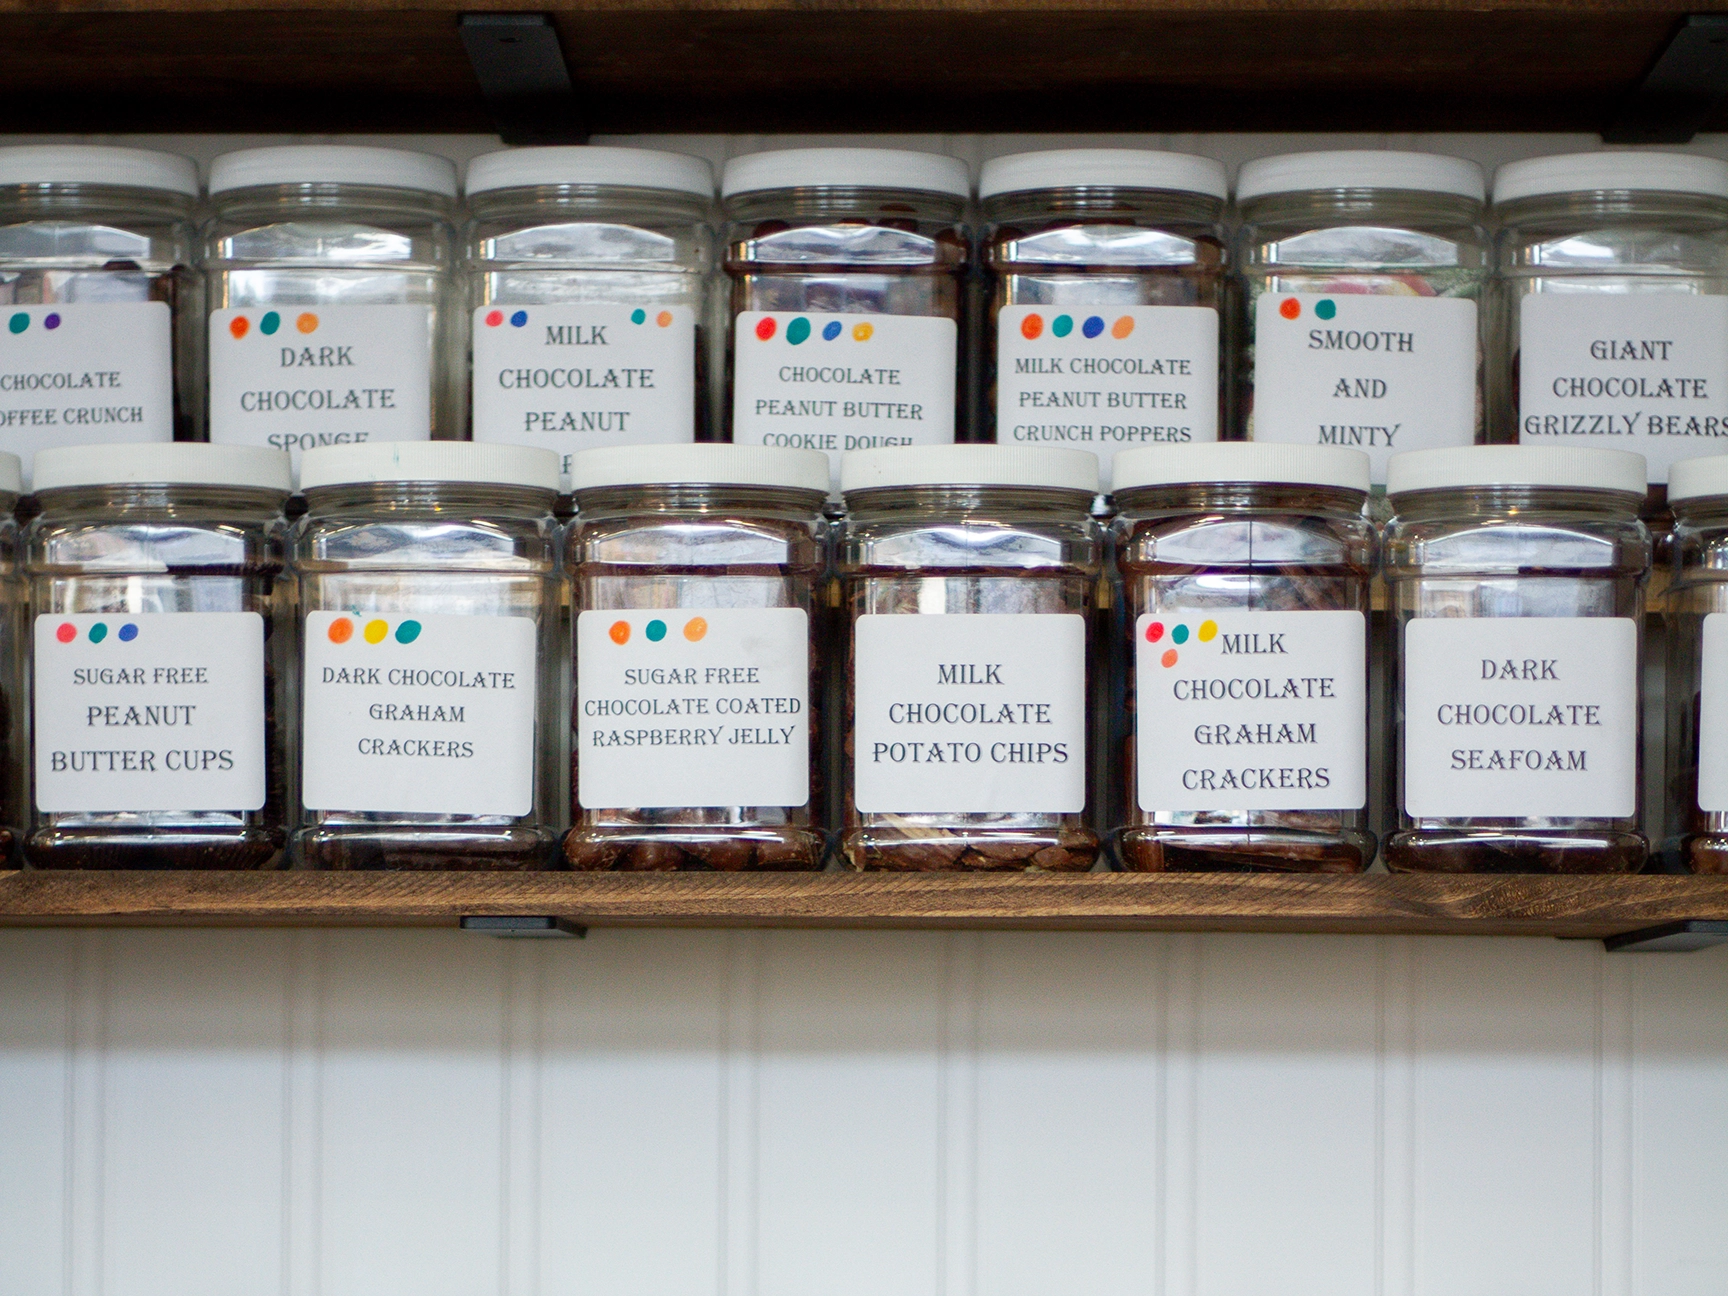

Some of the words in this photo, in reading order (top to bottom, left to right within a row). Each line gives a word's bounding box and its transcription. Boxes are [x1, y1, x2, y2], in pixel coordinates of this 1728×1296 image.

[545, 326, 608, 345] MILK
[1308, 329, 1414, 353] SMOOTH
[281, 346, 354, 367] DARK
[1590, 340, 1673, 361] GIANT
[779, 366, 901, 385] CHOCOLATE
[1015, 358, 1064, 374] MILK
[1070, 358, 1191, 375] CHOCOLATE
[0, 372, 121, 391] CHOCOLATE
[499, 368, 655, 389] CHOCOLATE
[1333, 378, 1387, 399] AND
[1552, 377, 1709, 399] CHOCOLATE
[240, 389, 396, 412] CHOCOLATE
[755, 399, 837, 416] PEANUT
[843, 401, 923, 421] BUTTER
[1019, 391, 1101, 407] PEANUT
[1107, 392, 1187, 410] BUTTER
[63, 407, 143, 425] CRUNCH
[525, 412, 630, 432] PEANUT
[1524, 411, 1642, 436] GRIZZLY
[763, 433, 837, 450] COOKIE
[844, 435, 912, 451] DOUGH
[1013, 425, 1093, 441] CRUNCH
[1100, 425, 1192, 443] POPPERS
[1318, 423, 1401, 447] MINTY
[1221, 633, 1288, 655] MILK
[73, 668, 146, 685] SUGAR
[153, 667, 208, 685] FREE
[322, 667, 381, 685] DARK
[388, 669, 515, 689] CHOCOLATE
[624, 668, 697, 685] SUGAR
[705, 667, 760, 685] FREE
[937, 664, 1004, 685] MILK
[1481, 659, 1559, 681] DARK
[1173, 678, 1336, 701] CHOCOLATE
[87, 705, 196, 727] PEANUT
[369, 703, 465, 723] GRAHAM
[585, 698, 709, 717] CHOCOLATE
[716, 698, 801, 714] COATED
[889, 703, 1052, 724] CHOCOLATE
[1437, 704, 1602, 726] CHOCOLATE
[593, 725, 724, 747] RASPBERRY
[728, 725, 795, 745] JELLY
[1194, 723, 1317, 746] GRAHAM
[358, 738, 474, 758] CRACKERS
[873, 742, 982, 763] POTATO
[990, 742, 1069, 764] CHIPS
[51, 750, 157, 772] BUTTER
[165, 749, 234, 771] CUPS
[1451, 749, 1587, 771] SEAFOAM
[1182, 767, 1330, 791] CRACKERS
